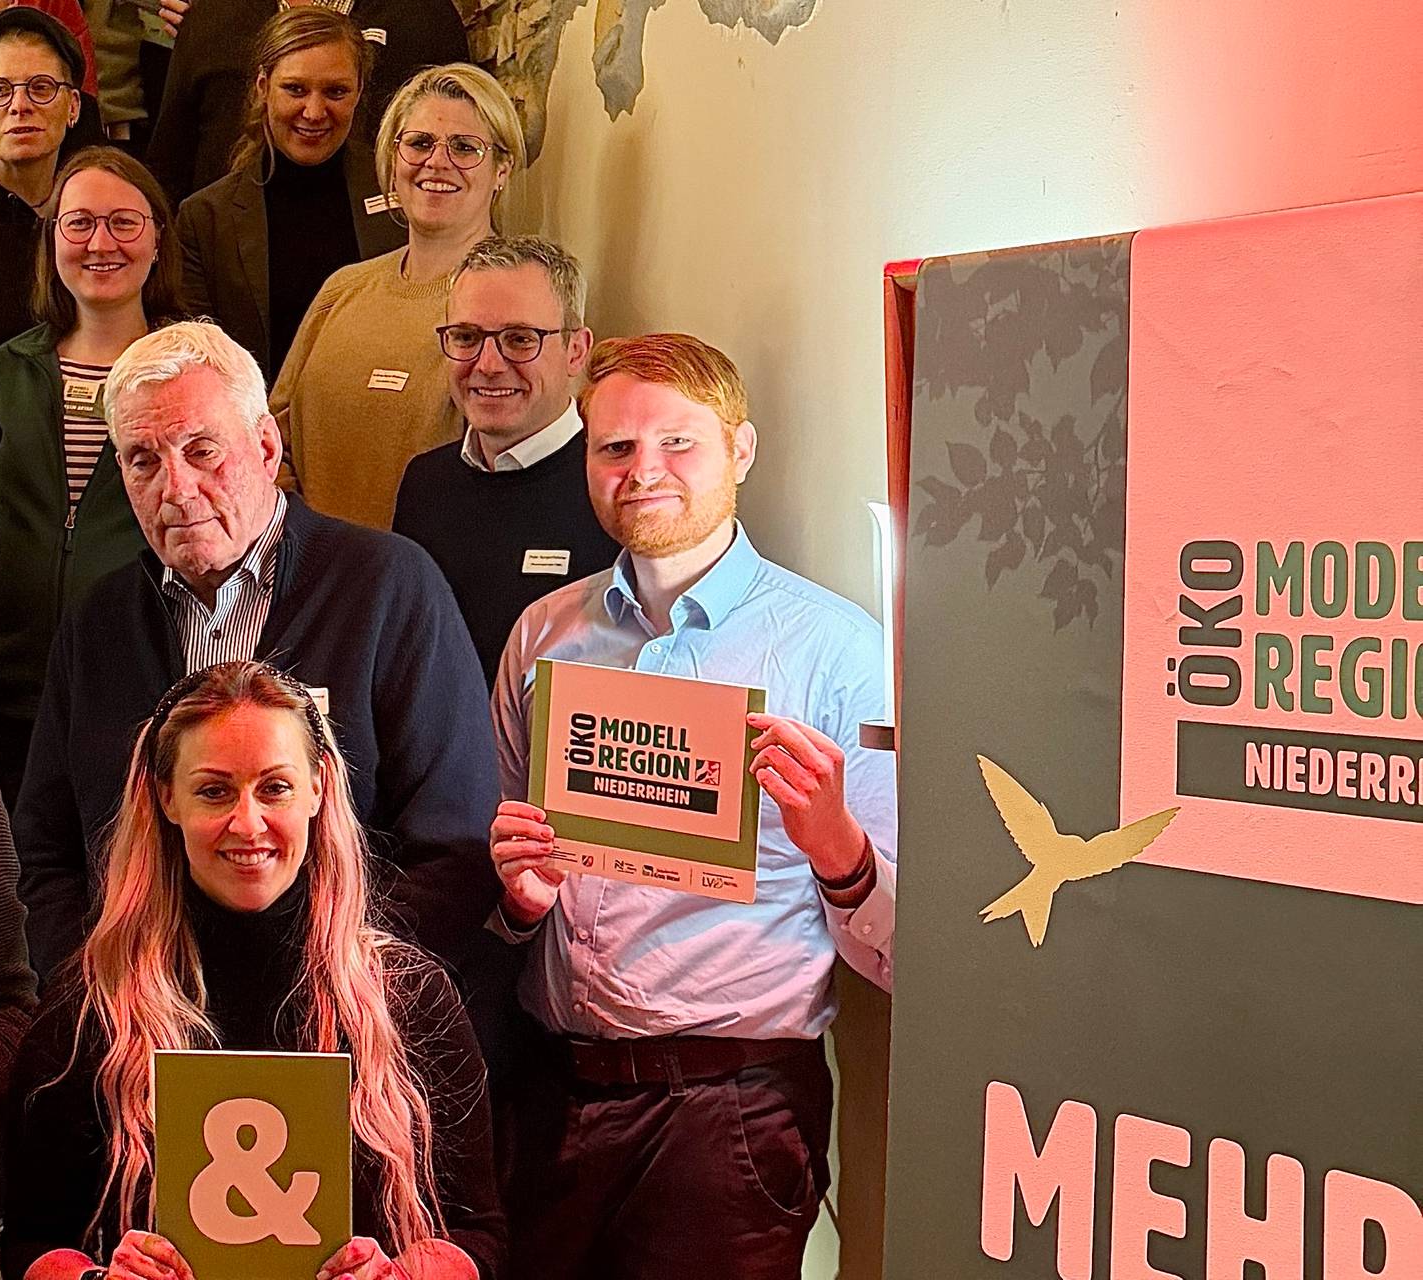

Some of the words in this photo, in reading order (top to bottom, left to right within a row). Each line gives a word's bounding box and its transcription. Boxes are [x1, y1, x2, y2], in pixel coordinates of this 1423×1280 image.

[1167, 540, 1244, 707] ÖKO
[1254, 632, 1423, 720] REGI
[565, 712, 597, 765] ÖKO
[597, 744, 691, 781] REGION
[599, 716, 691, 753] MODELL
[593, 776, 691, 806] NIEDERRHEIN
[1244, 741, 1423, 806] NIEDERR
[188, 1097, 322, 1246] &
